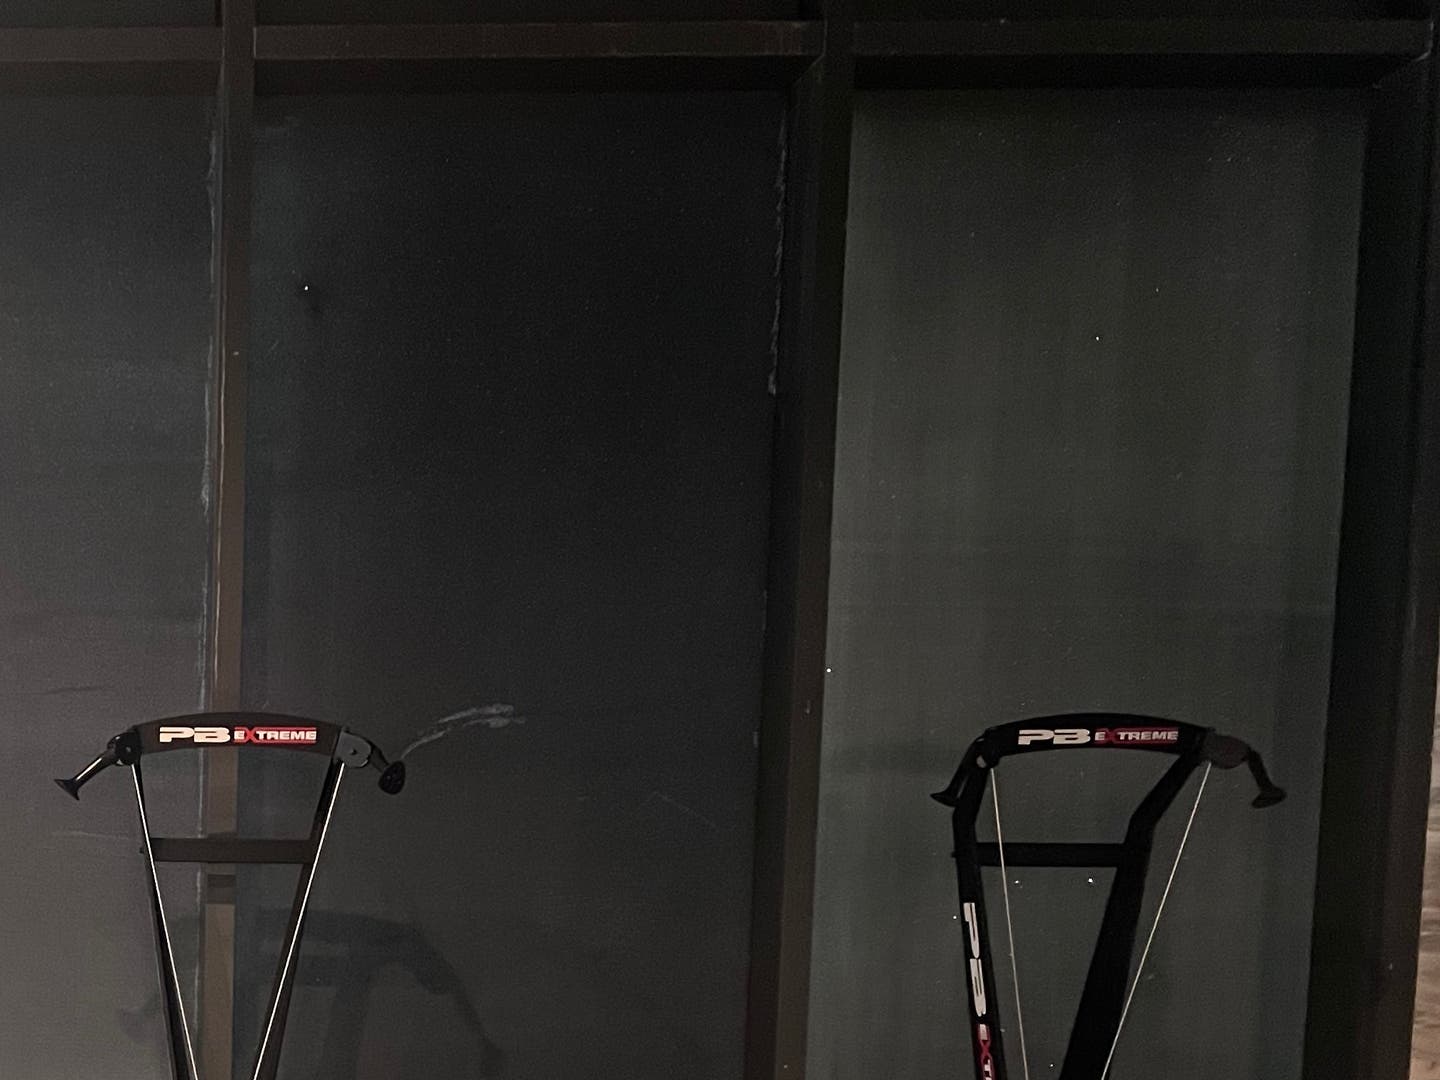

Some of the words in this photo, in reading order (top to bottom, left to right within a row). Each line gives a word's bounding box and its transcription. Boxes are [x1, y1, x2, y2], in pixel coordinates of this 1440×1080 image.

[160, 727, 231, 743] PB
[233, 727, 317, 744] EXTREME
[1018, 728, 1091, 745] PB
[1094, 728, 1179, 744] EXTREME
